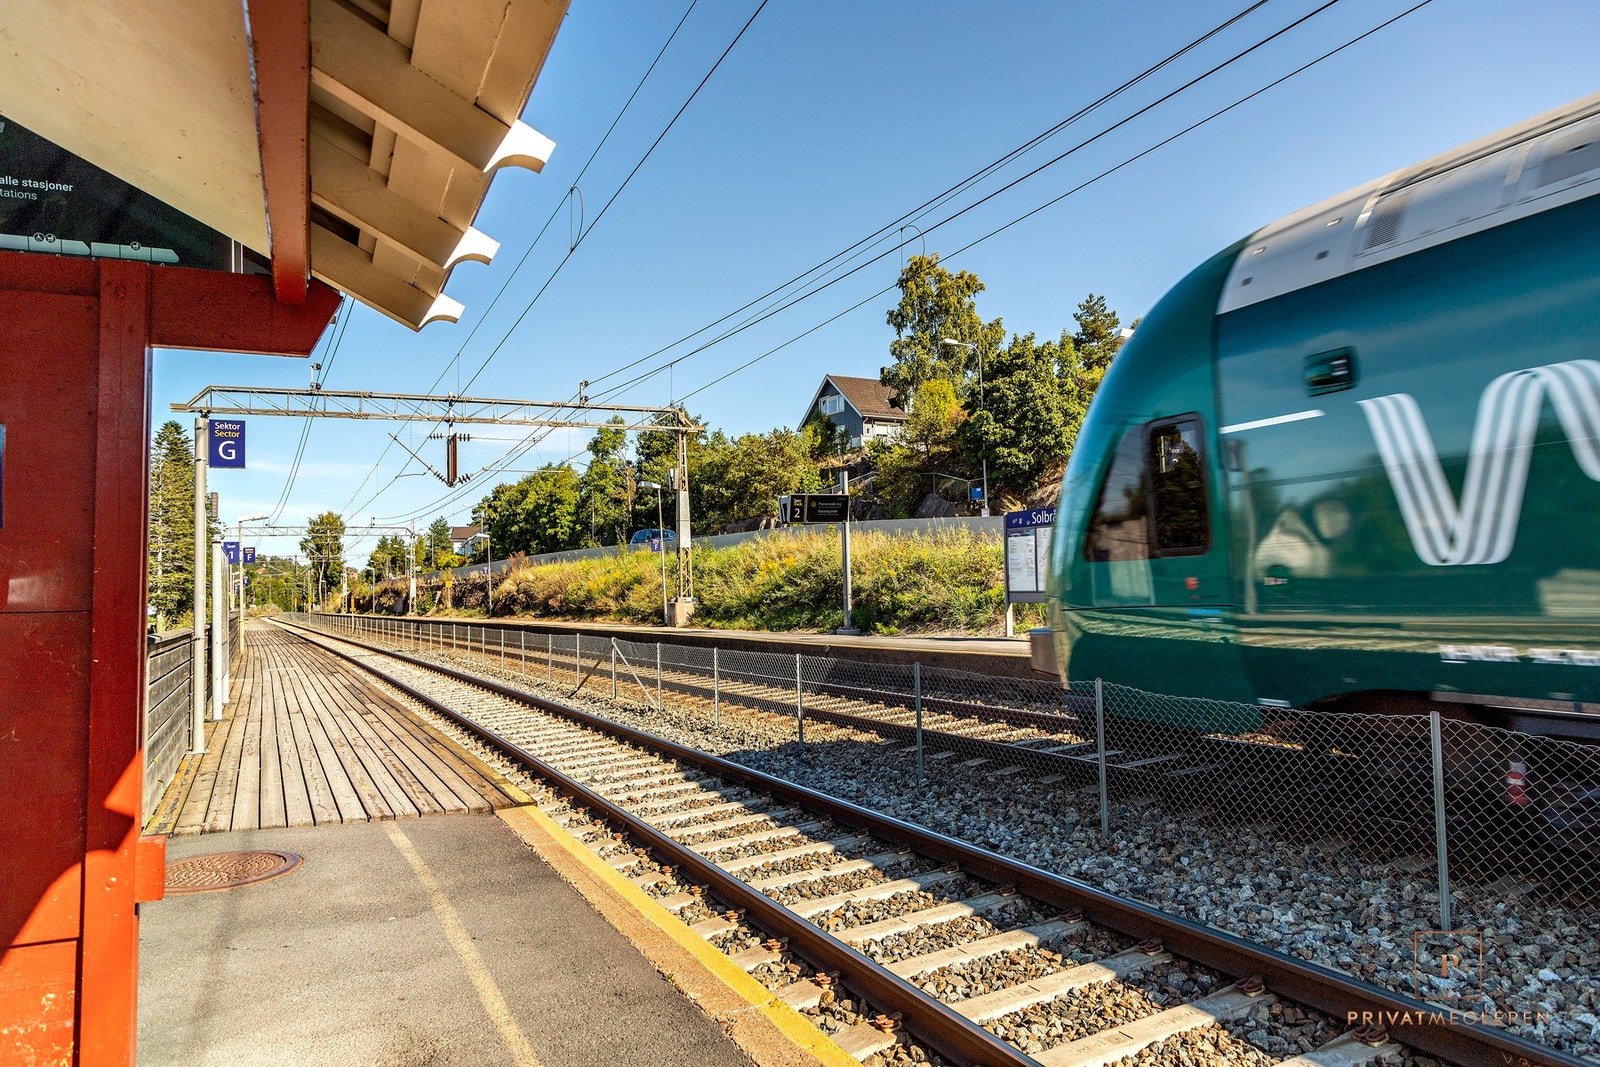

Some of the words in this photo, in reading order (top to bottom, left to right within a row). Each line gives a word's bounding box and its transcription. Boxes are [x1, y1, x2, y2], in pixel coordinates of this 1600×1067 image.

[22, 179, 74, 192] stasjoner
[214, 422, 240, 430] Sektor
[214, 430, 240, 438] Sector
[218, 440, 236, 460] G
[794, 508, 800, 518] 2
[229, 551, 234, 560] 1
[247, 553, 253, 561] F
